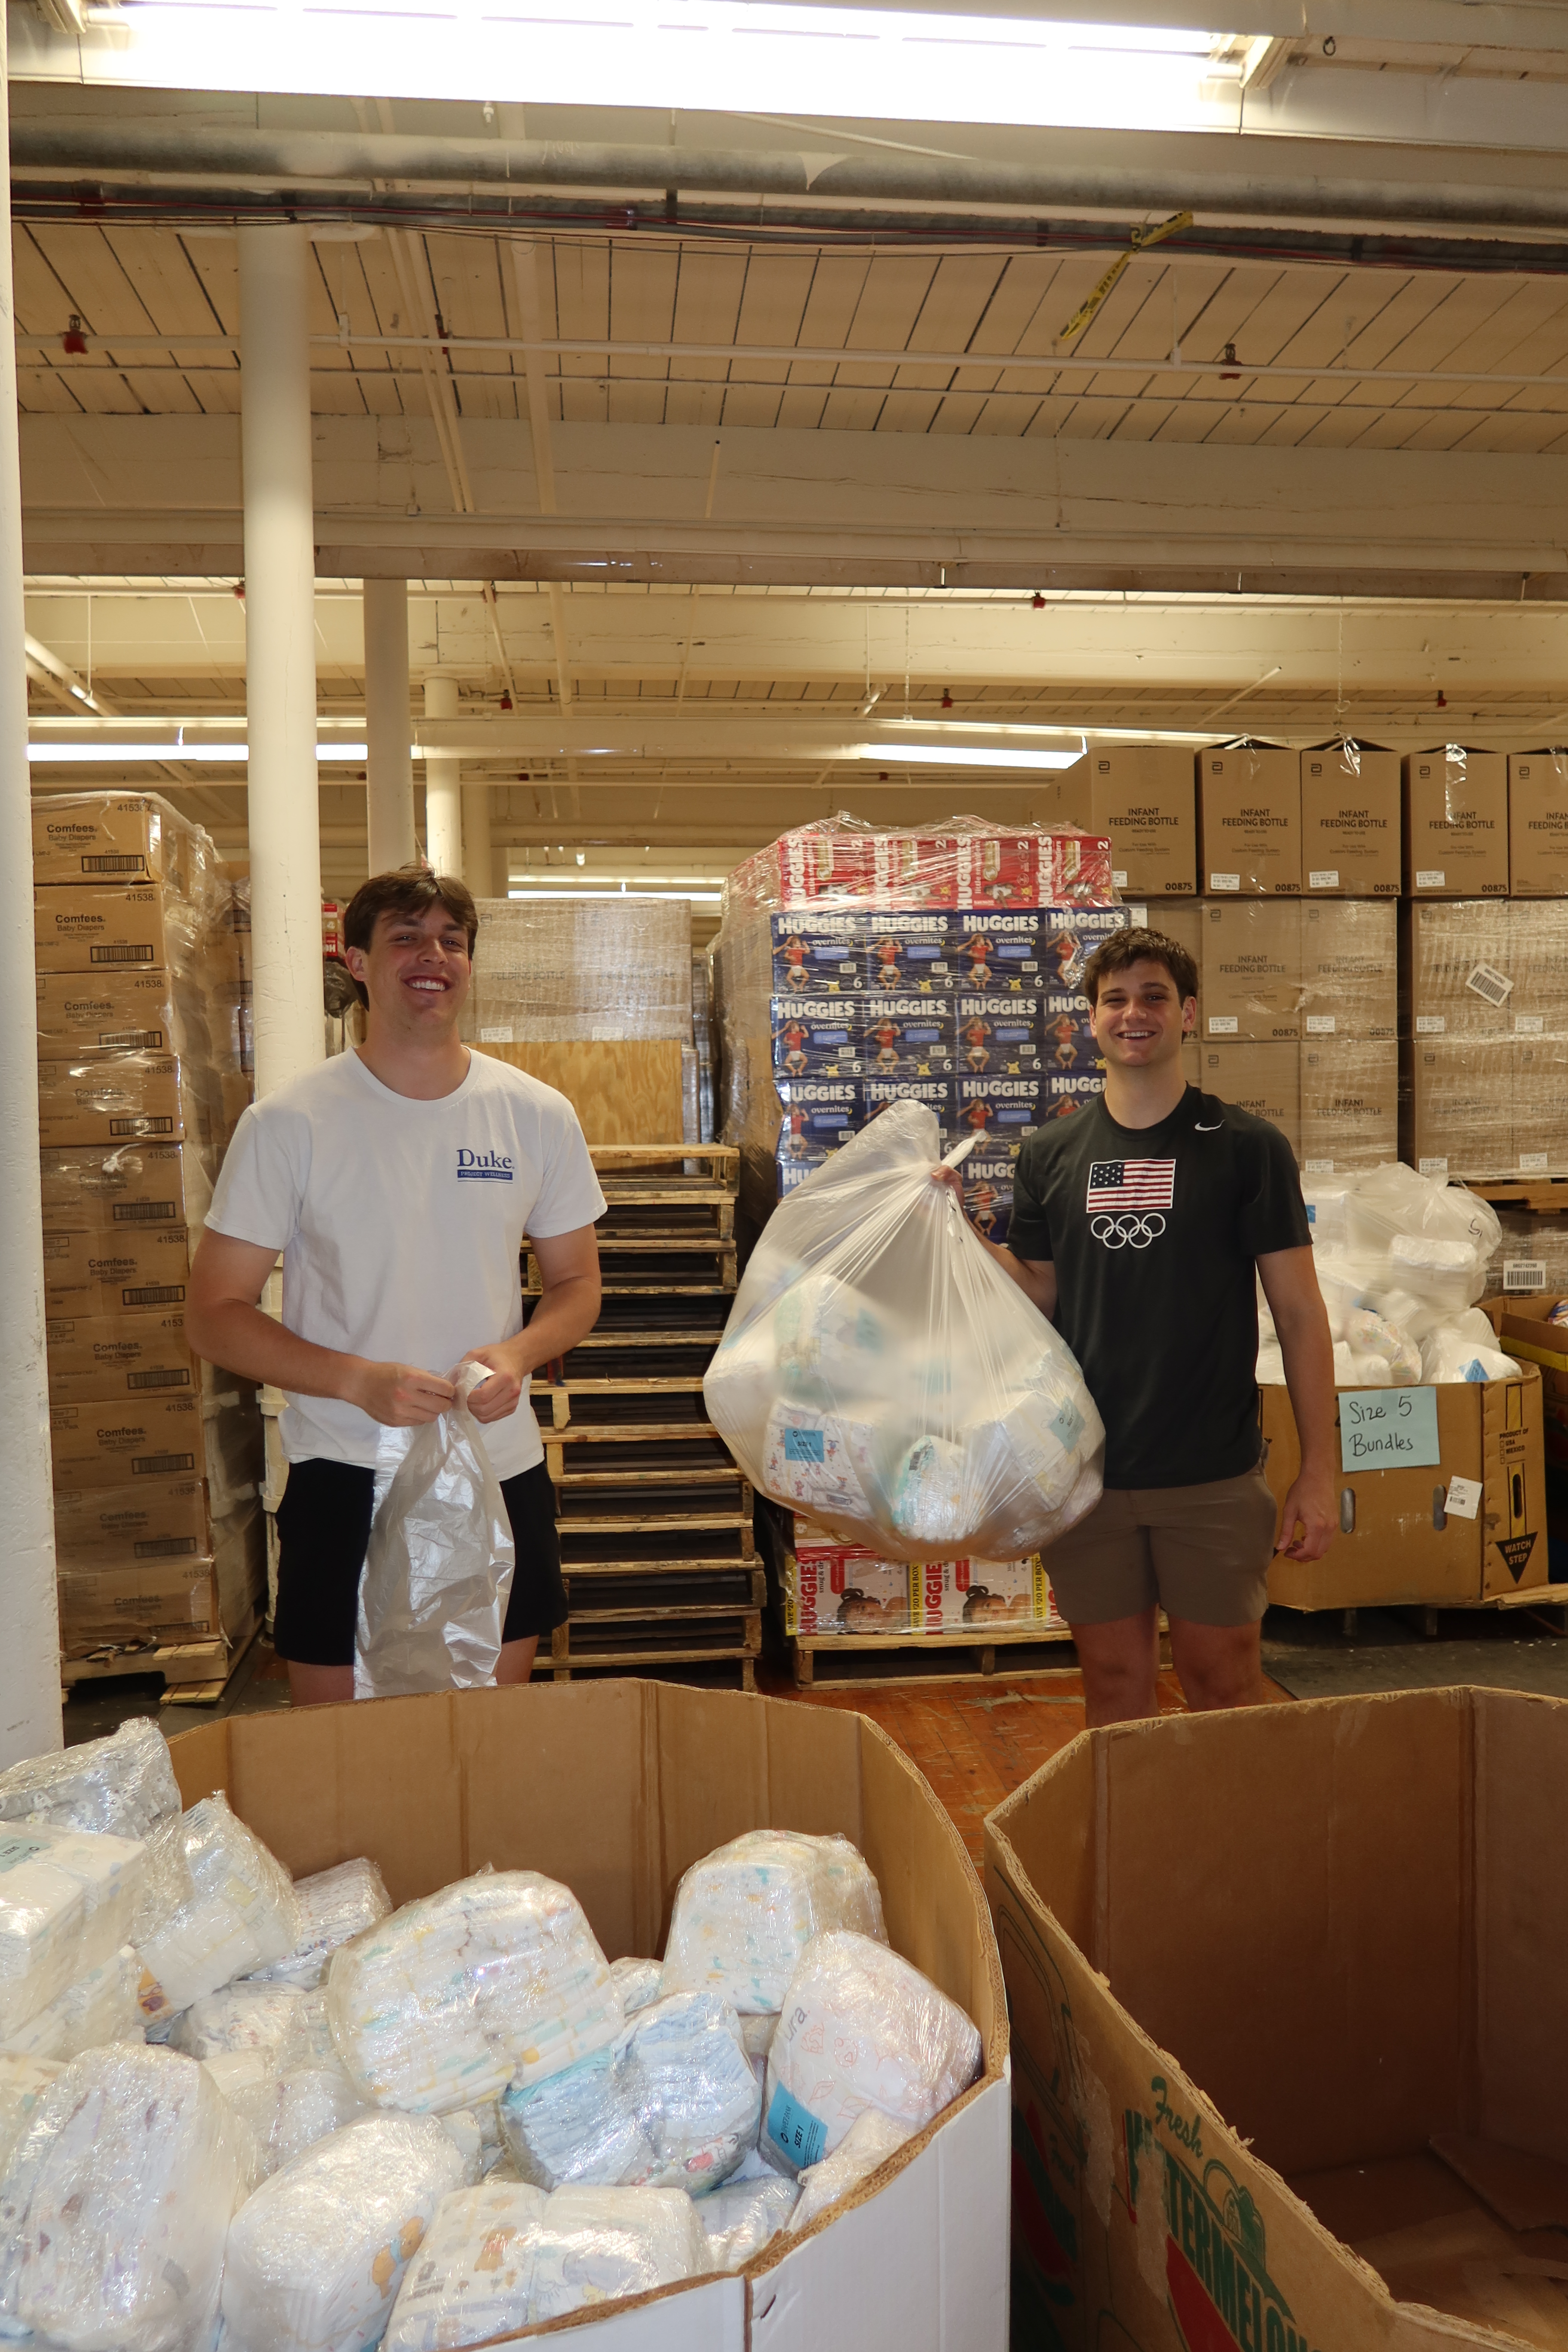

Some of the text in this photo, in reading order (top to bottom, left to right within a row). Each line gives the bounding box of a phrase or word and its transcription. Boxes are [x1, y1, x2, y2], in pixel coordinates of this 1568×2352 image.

[1128, 808, 1160, 816] INFANT
[1240, 808, 1271, 817] INFANT
[1338, 810, 1369, 818] INFANT
[1447, 812, 1477, 820] NFANT
[1546, 812, 1568, 821] INFAN
[1109, 817, 1179, 826] FEEDING BOTTLE
[1222, 818, 1289, 827] FEEDING BOTTLE
[1320, 819, 1388, 828] FEEDING BOTTLE
[1429, 821, 1495, 829] FEEDING BOTTLE
[1528, 821, 1563, 830] FEEDING
[47, 824, 95, 833] Comfees
[935, 839, 947, 849] 2
[1017, 840, 1029, 850] 2
[1097, 840, 1109, 850] 2
[787, 837, 807, 908] UGGIES
[956, 837, 973, 910] HUGGIES
[1037, 836, 1054, 908] HUGGIES
[1165, 882, 1193, 891] 00875
[1275, 884, 1301, 892] 00875
[1374, 884, 1400, 892] 00875
[1482, 884, 1507, 892] 00875
[126, 893, 153, 902] 41538
[55, 914, 103, 923] Comfees
[1050, 912, 1126, 930] HUGGIES
[778, 916, 858, 935] HUGGIES
[872, 916, 949, 933] HUGGIES
[963, 915, 1039, 932] HUGGIES
[812, 937, 851, 946] overnites
[904, 937, 943, 945] overnites
[995, 936, 1033, 945] overnites
[1082, 933, 1110, 941] overni
[1220, 964, 1286, 973] FEEDING BOTTLE
[134, 980, 162, 988] 41538
[853, 977, 863, 989] 6
[945, 977, 954, 988] 6
[1034, 976, 1044, 987] 6
[64, 1001, 112, 1011] Comfees
[778, 1001, 855, 1020] HUGGIES
[870, 999, 947, 1017] HUGGIES
[961, 998, 1038, 1016] HUGGIES
[811, 1021, 850, 1031] overnites
[903, 1020, 941, 1029] overnites
[993, 1019, 1032, 1028] overnites
[1272, 1029, 1298, 1037] 00875
[852, 1061, 862, 1073] 6
[943, 1059, 952, 1071] 6
[1032, 1058, 1042, 1070] 6
[145, 1065, 172, 1074] 41538
[963, 1080, 1039, 1098] HUGGIES
[1051, 1077, 1106, 1095] HUGGI
[791, 1084, 856, 1102] UGGIES
[871, 1082, 949, 1100] HUGGIES
[995, 1101, 1033, 1110] overnites
[1237, 1099, 1266, 1108] INFANT
[1335, 1099, 1364, 1107] INFANT
[811, 1105, 850, 1114] overnites
[1255, 1108, 1284, 1117] BOTTLE
[1354, 1107, 1382, 1116] BOTTLE
[147, 1151, 175, 1159] 41538
[456, 1148, 512, 1169] Duke
[968, 1162, 1015, 1180] HUGG
[157, 1234, 185, 1243] 41538
[88, 1257, 135, 1268] Comfees
[161, 1318, 184, 1327] 4153
[93, 1341, 139, 1352] Comfees
[165, 1403, 193, 1412] 41538
[1349, 1395, 1412, 1424] Size 5
[96, 1427, 144, 1438] Comfees
[1499, 1430, 1522, 1439] PRODUCT
[1349, 1432, 1413, 1457] Bundles
[1506, 1445, 1525, 1454] MEXICO
[168, 1486, 196, 1496] 41538
[99, 1510, 147, 1522] Comfees
[1505, 1539, 1531, 1553] WATCH
[1509, 1553, 1528, 1565] STEP
[925, 1563, 943, 1635] HUGGIE
[1151, 2076, 1204, 2158] Fresh
[794, 2129, 803, 2149] SIZE
